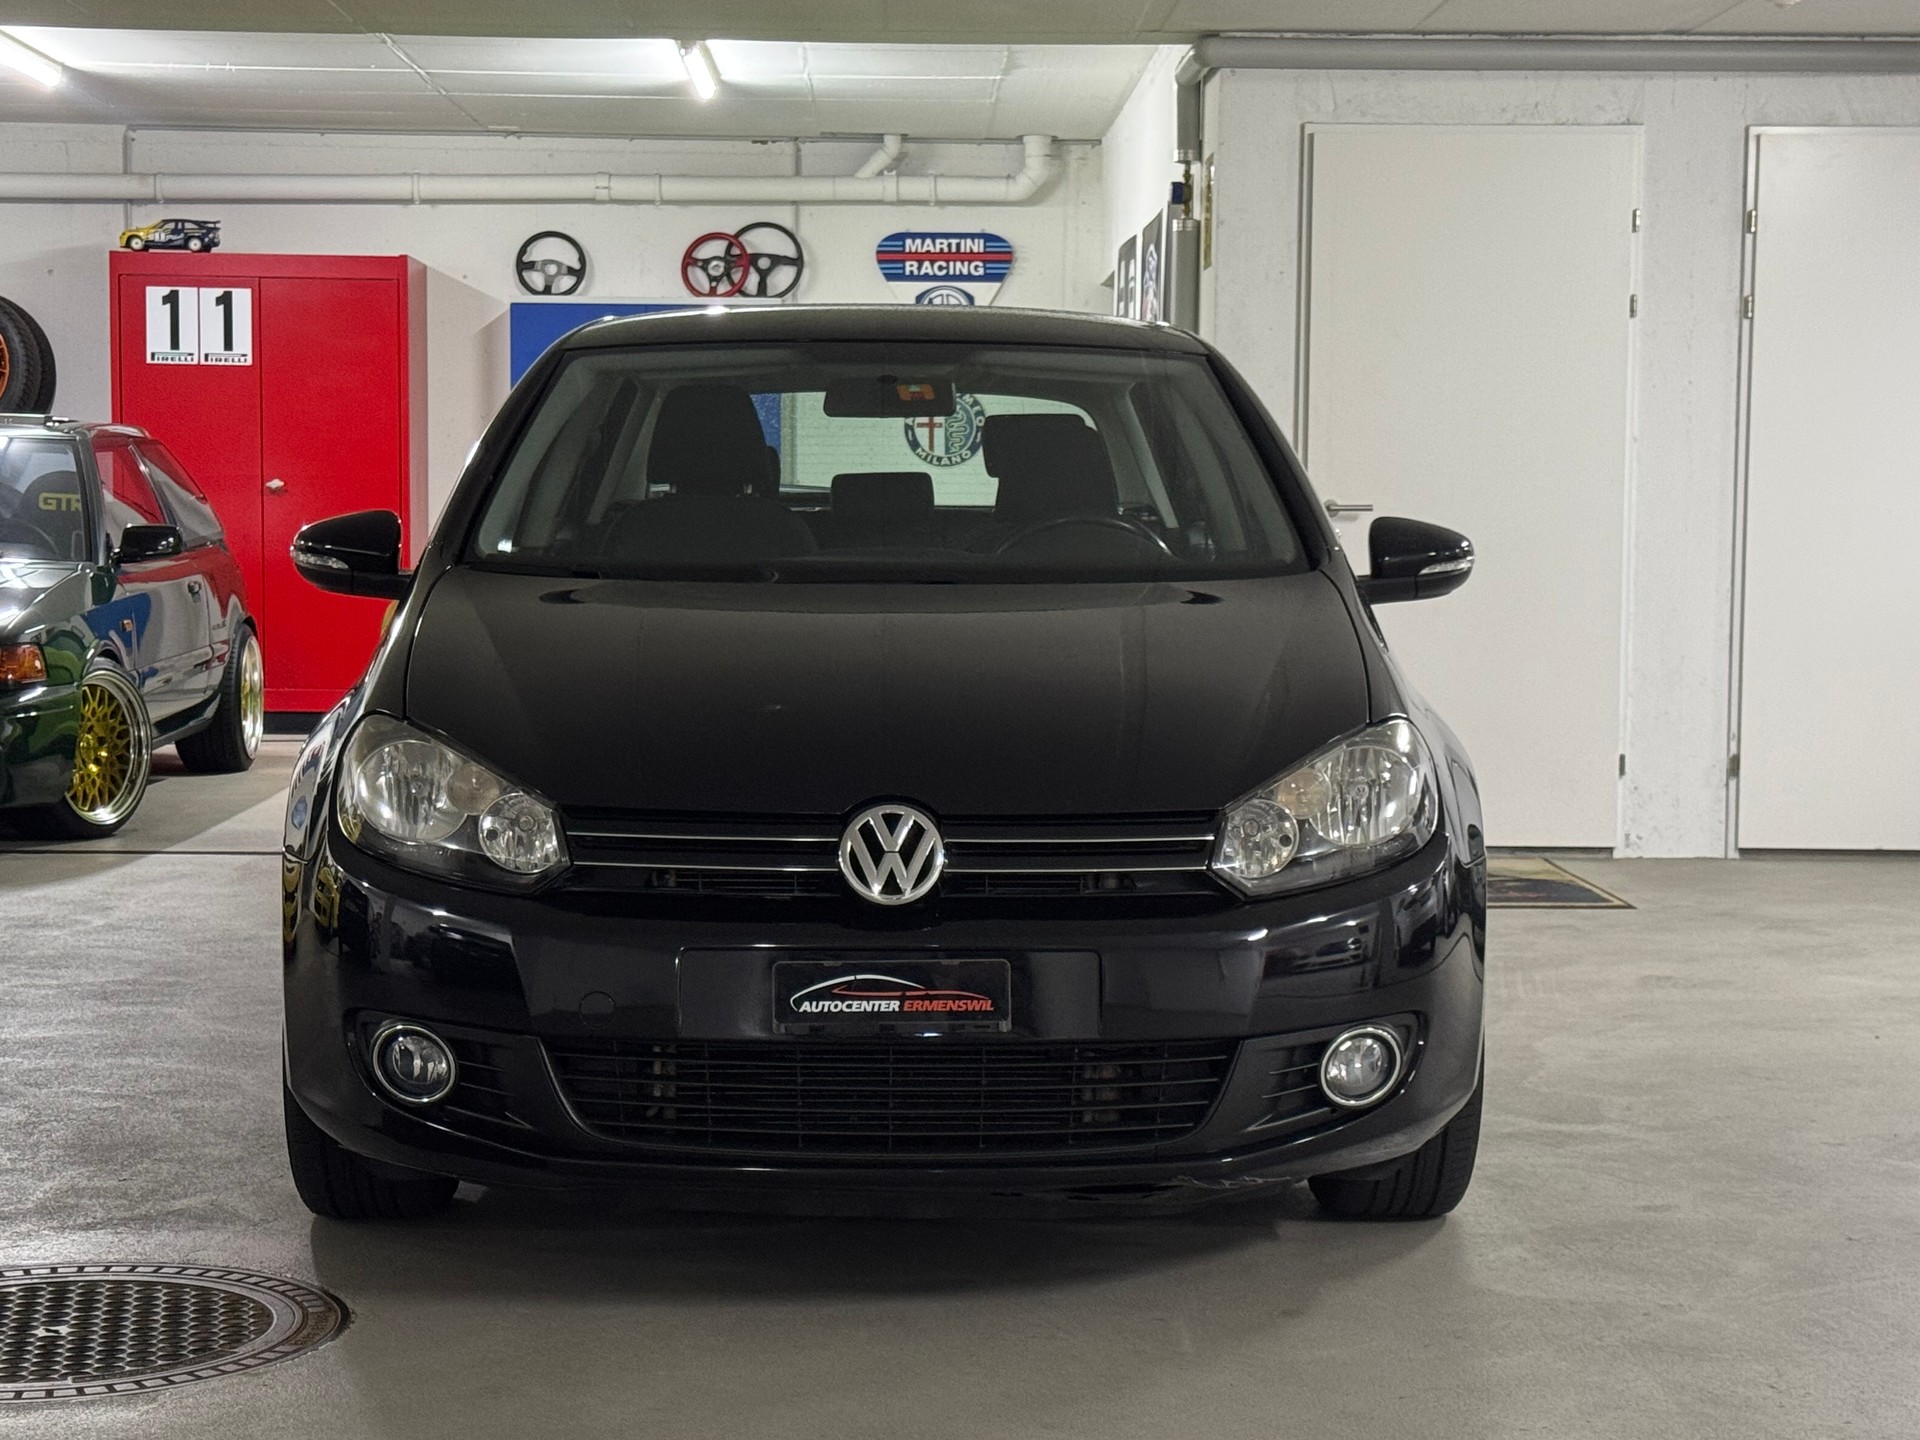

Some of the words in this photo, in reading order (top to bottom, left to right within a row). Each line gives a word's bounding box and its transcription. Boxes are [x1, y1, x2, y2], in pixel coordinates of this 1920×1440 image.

[904, 238, 985, 254] MARTINI
[904, 260, 985, 276] RACING
[915, 447, 972, 466] MILANO
[799, 1000, 900, 1013] AUTOCENTER
[903, 1000, 994, 1012] ERMENSWIL
